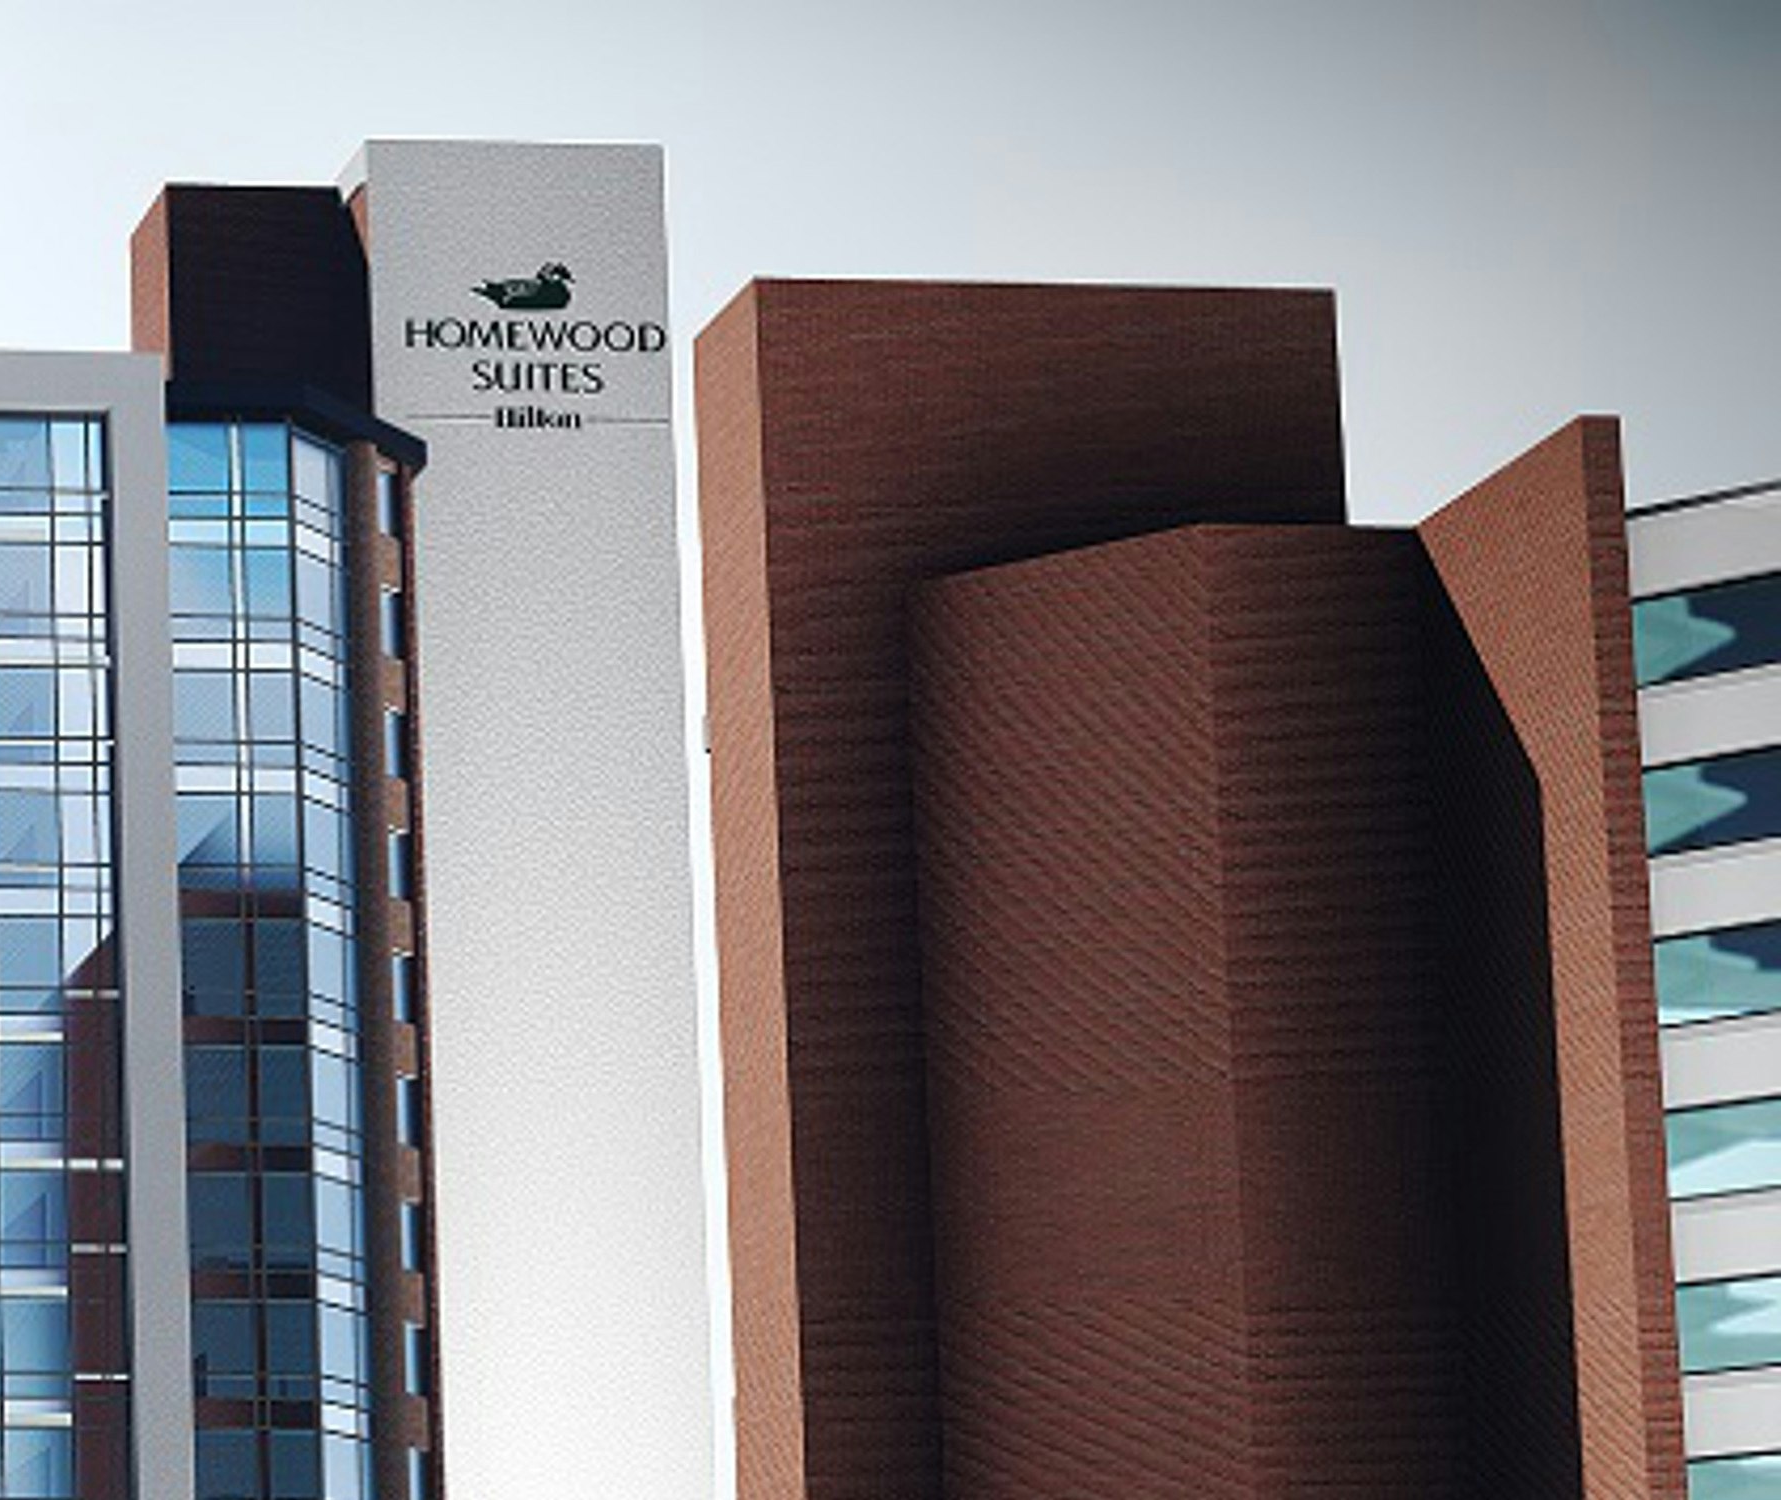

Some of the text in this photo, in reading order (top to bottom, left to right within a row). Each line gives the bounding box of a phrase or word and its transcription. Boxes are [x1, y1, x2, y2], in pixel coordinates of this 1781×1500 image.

[404, 317, 667, 352] HOMEWOOD
[471, 358, 605, 394] SUITES
[494, 405, 582, 429] Hilton
